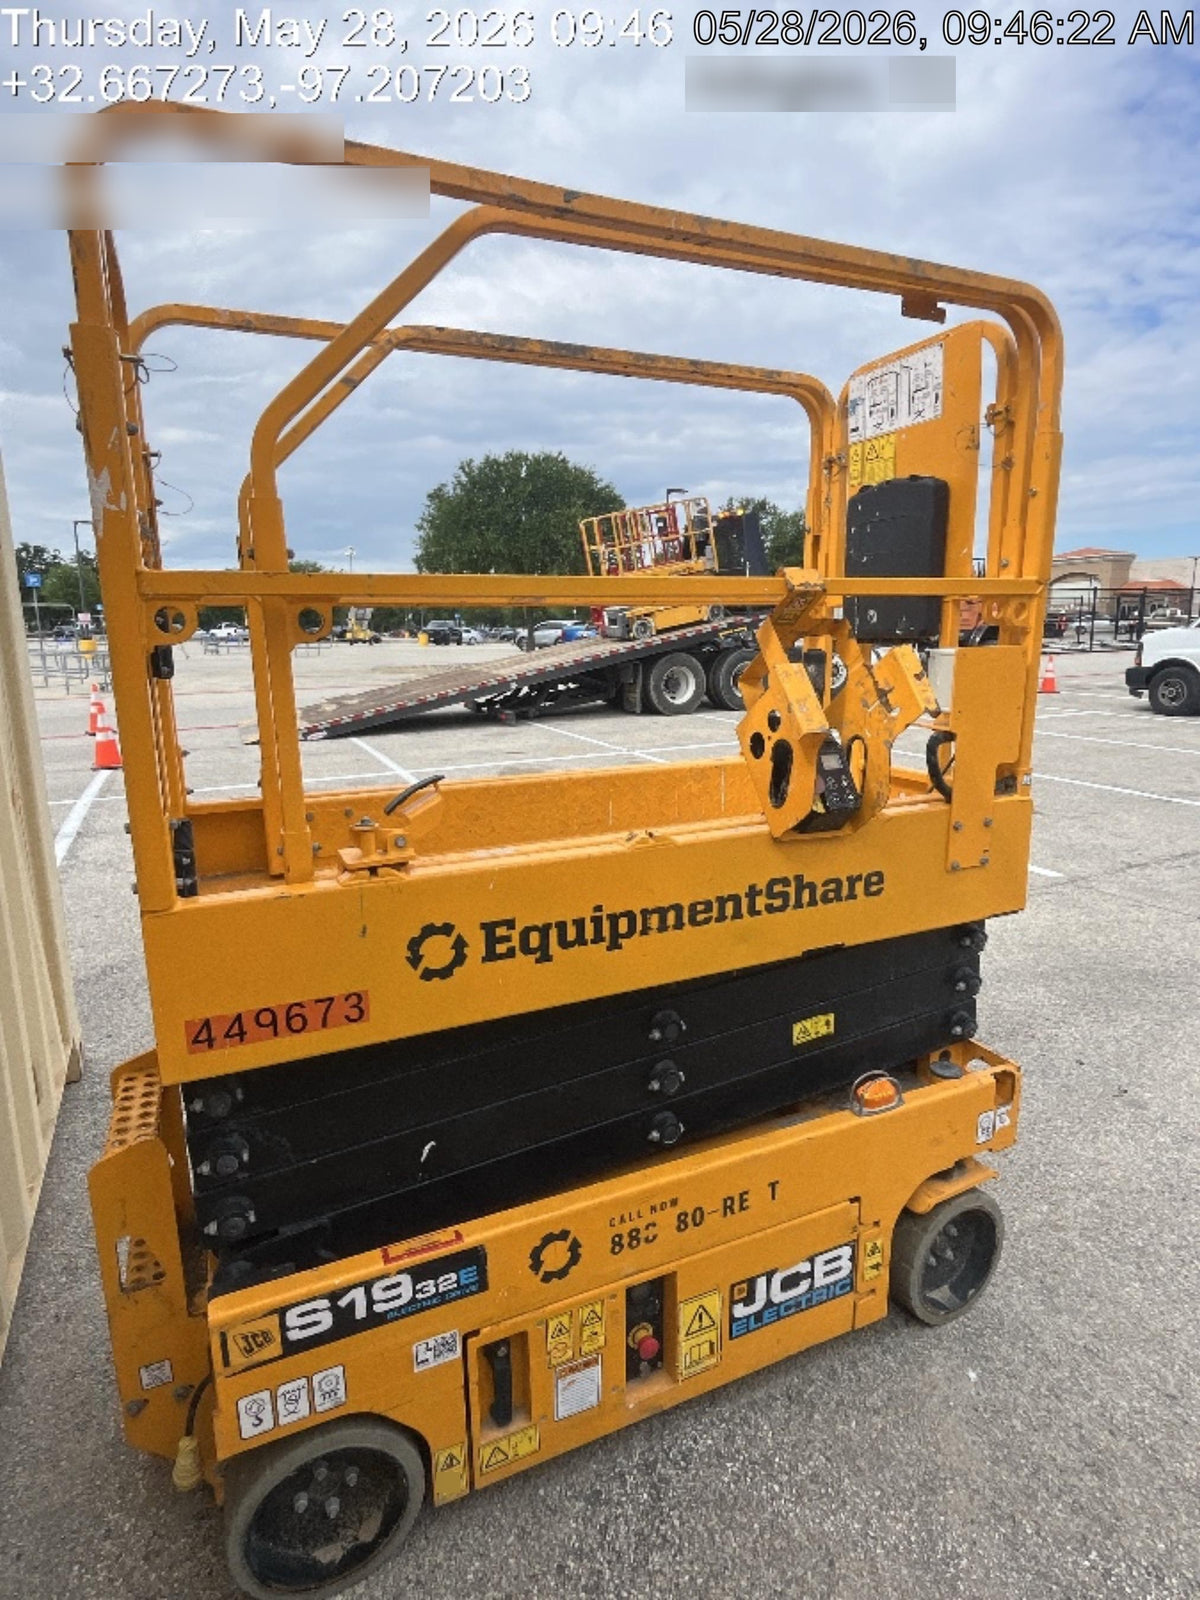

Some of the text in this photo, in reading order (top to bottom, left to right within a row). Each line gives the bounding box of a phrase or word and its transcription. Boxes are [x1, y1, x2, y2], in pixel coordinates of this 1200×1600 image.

[480, 870, 885, 965] EquipmentShare
[191, 992, 365, 1048] 449673
[609, 1197, 679, 1228] CALL NOW
[731, 1245, 853, 1318] JCB
[731, 1279, 851, 1338] ELECTRIC
[240, 1330, 274, 1356] JCB
